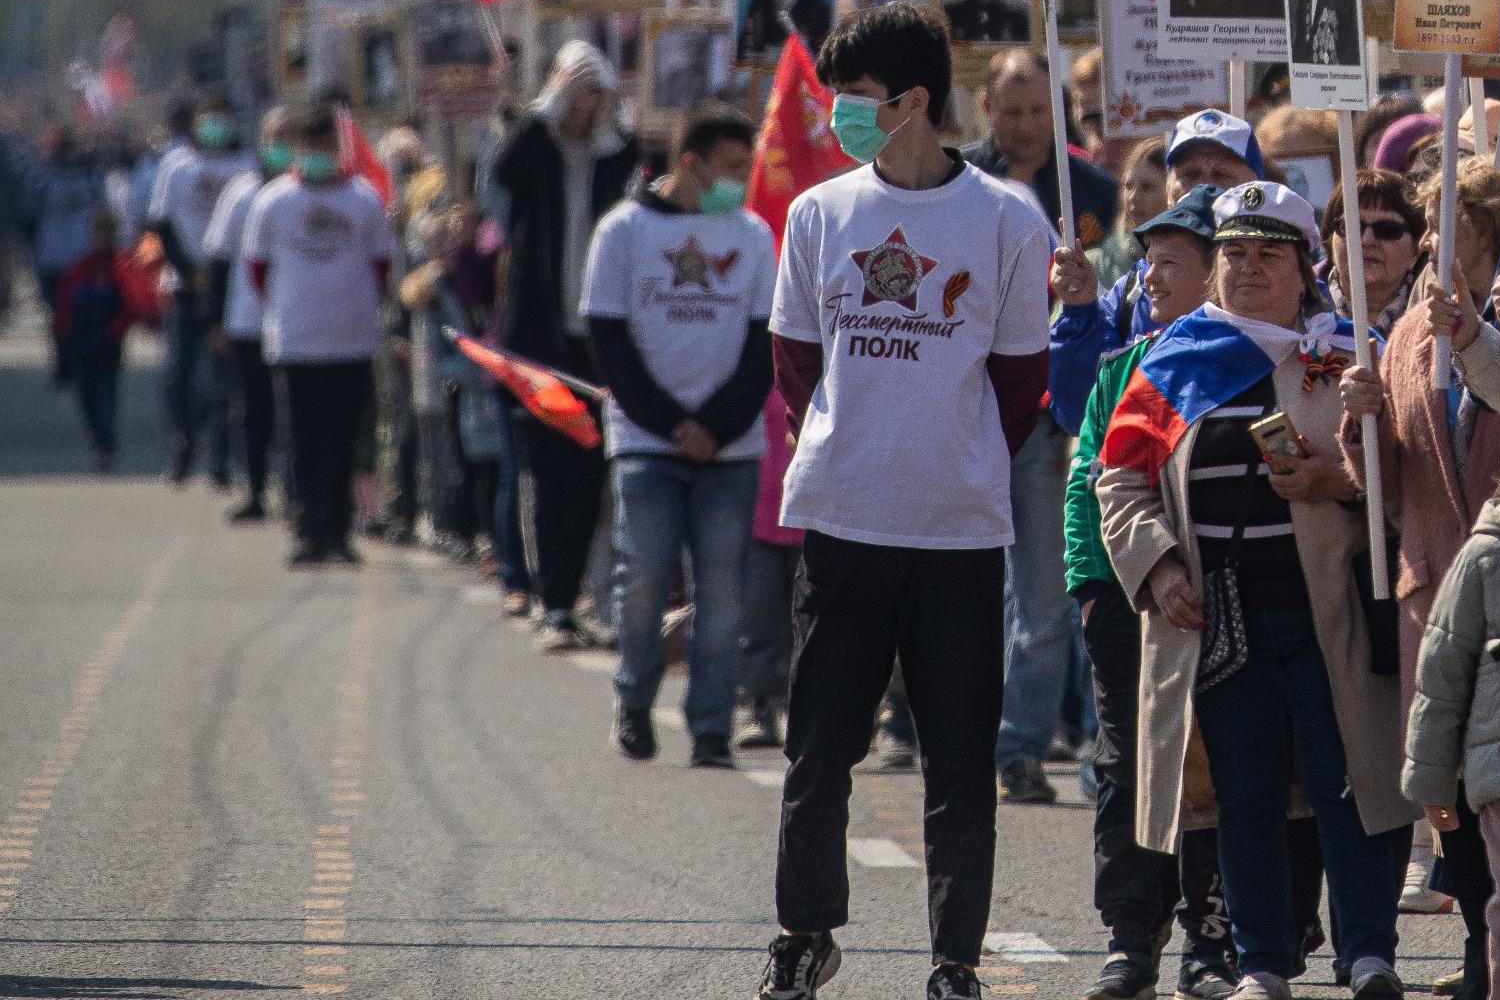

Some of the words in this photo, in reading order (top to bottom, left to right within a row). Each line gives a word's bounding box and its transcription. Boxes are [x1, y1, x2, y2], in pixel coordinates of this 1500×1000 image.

[1427, 3, 1472, 17] ШЛЯХОВ
[1213, 24, 1250, 36] Георгий
[849, 335, 921, 362] ПОЛК
